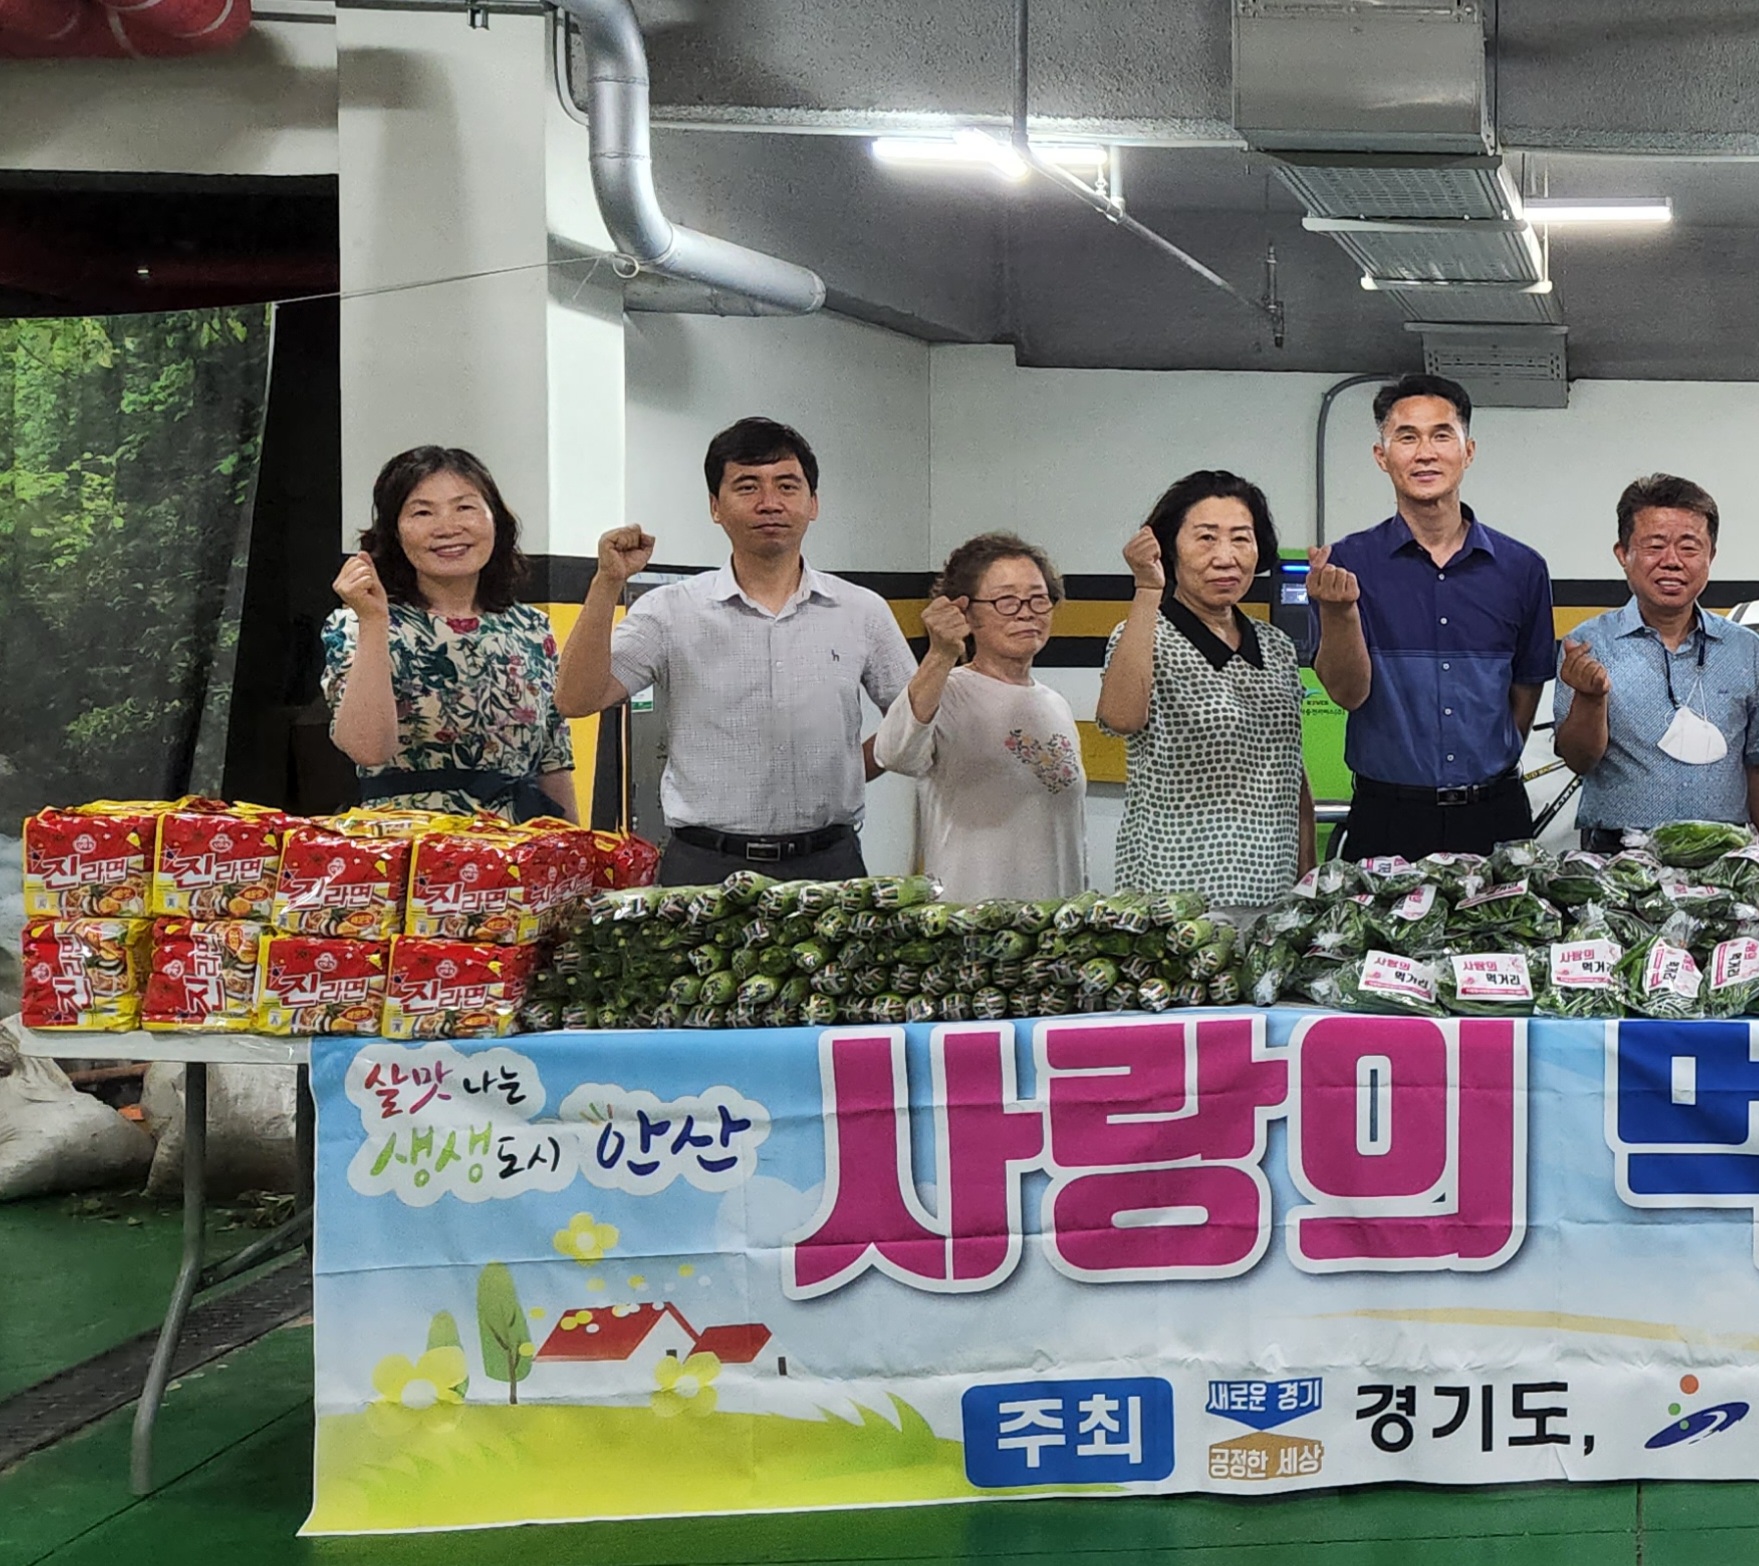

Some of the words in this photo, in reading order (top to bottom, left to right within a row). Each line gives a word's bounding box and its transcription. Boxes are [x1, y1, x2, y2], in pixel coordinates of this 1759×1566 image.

[42, 853, 129, 891] 진라면
[173, 852, 264, 890] 진라면
[287, 876, 374, 911] 진라면
[425, 881, 510, 917] 진라면
[182, 931, 227, 1015] 진라면
[278, 971, 369, 1009] 진라면
[1394, 971, 1430, 989] 먹거리
[1485, 973, 1521, 985] 먹거리
[401, 978, 489, 1016] 진라면
[364, 1060, 454, 1119] 살맛
[463, 1065, 527, 1105] 나는
[596, 1104, 751, 1176] 안산
[795, 1018, 1513, 1288] 사랑의
[1208, 1381, 1267, 1412] 새로운
[1277, 1380, 1321, 1412] 경기
[997, 1393, 1143, 1469] 주최
[1356, 1381, 1596, 1456] 경기도,
[1209, 1448, 1269, 1479] 공정한
[1276, 1445, 1322, 1476] 세상
